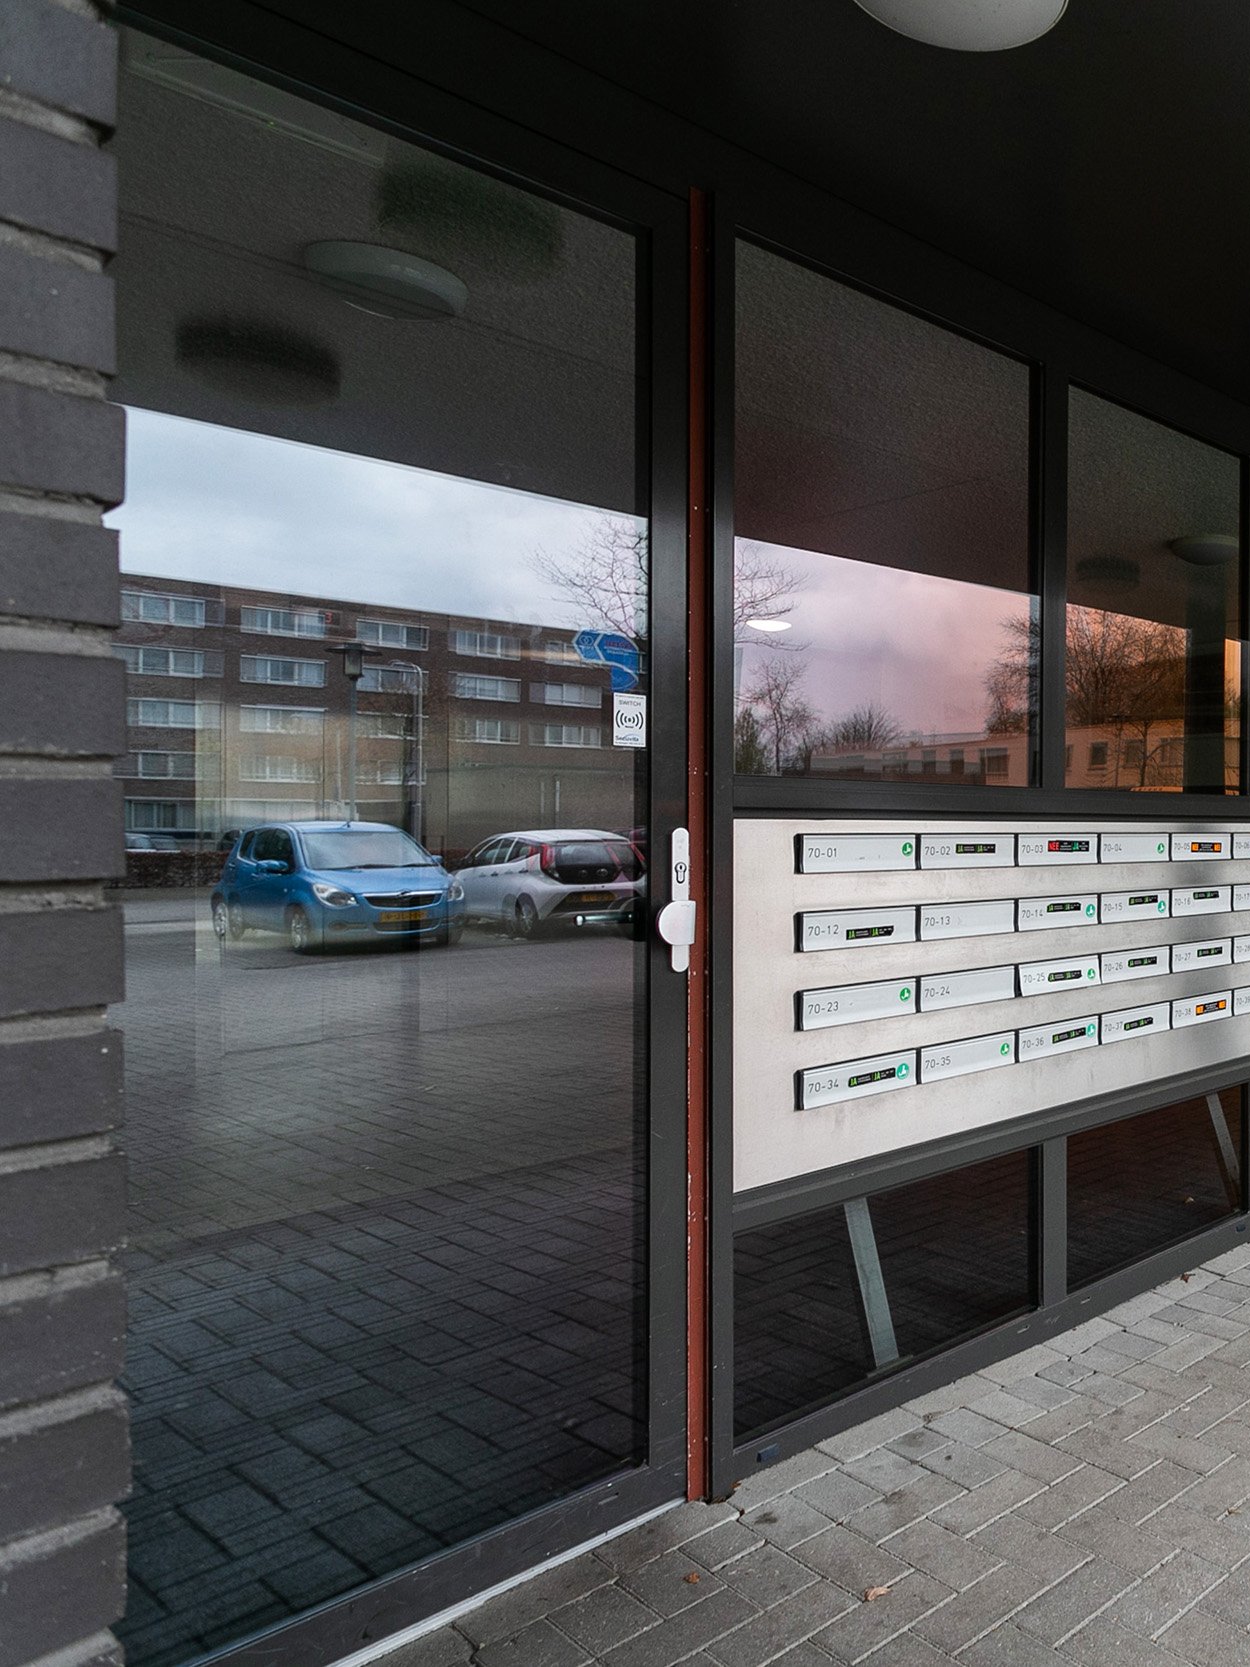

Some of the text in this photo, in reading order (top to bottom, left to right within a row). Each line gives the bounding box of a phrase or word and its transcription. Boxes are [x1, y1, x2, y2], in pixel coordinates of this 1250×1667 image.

[925, 846, 951, 856] 70-02
[1022, 844, 1043, 854] 70-03
[1049, 841, 1059, 851] NEE
[808, 848, 837, 858] 70-01
[1104, 903, 1123, 911] 70-15
[1174, 898, 1191, 906] 70-16
[1022, 909, 1043, 918] 70-14
[925, 916, 951, 927] 70-13
[808, 925, 839, 936] 70-12
[1174, 952, 1191, 961] 70-27
[1104, 962, 1123, 972] 70-26
[1023, 973, 1046, 983] 70-25
[924, 987, 950, 998] 70-24
[808, 1002, 839, 1014] 70-23
[1104, 1022, 1123, 1032] 70-37
[1022, 1038, 1045, 1049] 70-36
[925, 1056, 951, 1069] 70-35
[808, 1079, 839, 1093] 70-34
